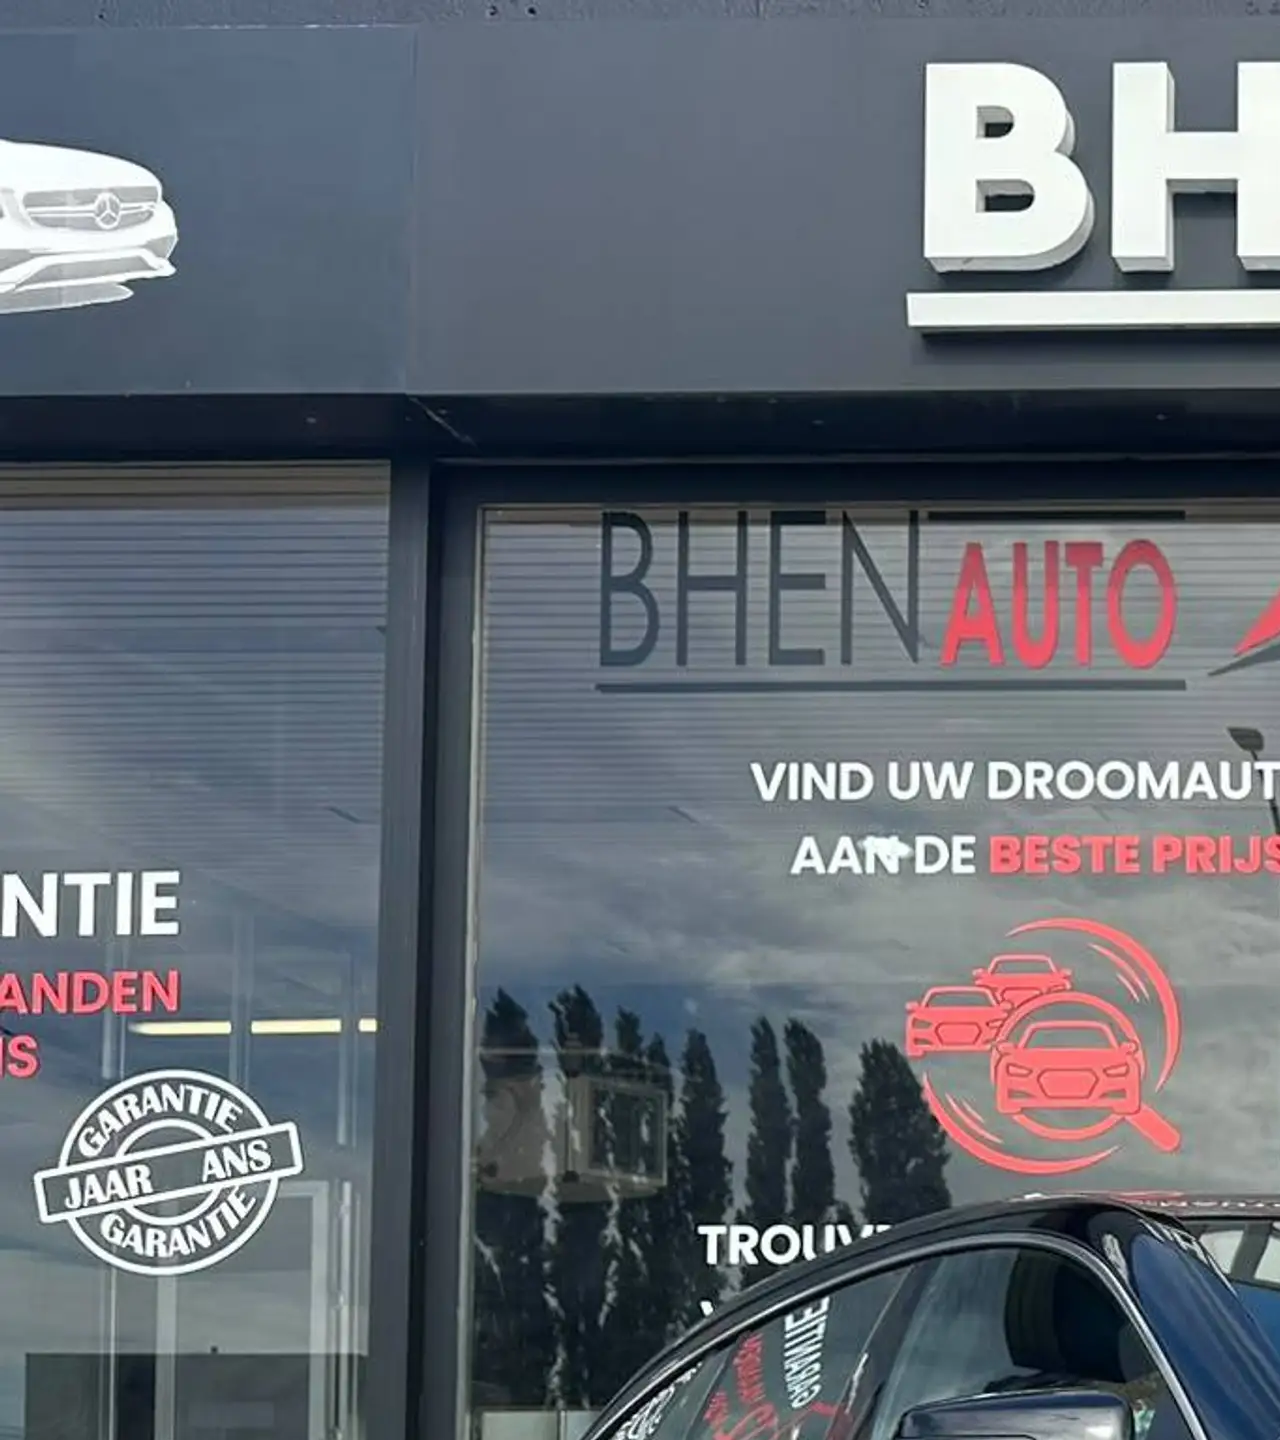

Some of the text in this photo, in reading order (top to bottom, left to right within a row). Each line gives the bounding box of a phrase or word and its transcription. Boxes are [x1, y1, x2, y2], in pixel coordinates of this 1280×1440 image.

[750, 761, 875, 802] VIND
[888, 760, 975, 801] UW
[790, 835, 901, 875] AAN
[914, 834, 977, 875] DE
[988, 833, 1142, 876] BESTE
[77, 1081, 244, 1160] GARANTIE
[63, 1140, 273, 1212] JAAR ANS
[99, 1188, 257, 1260] GARANTIE
[697, 1222, 893, 1266] TROU
